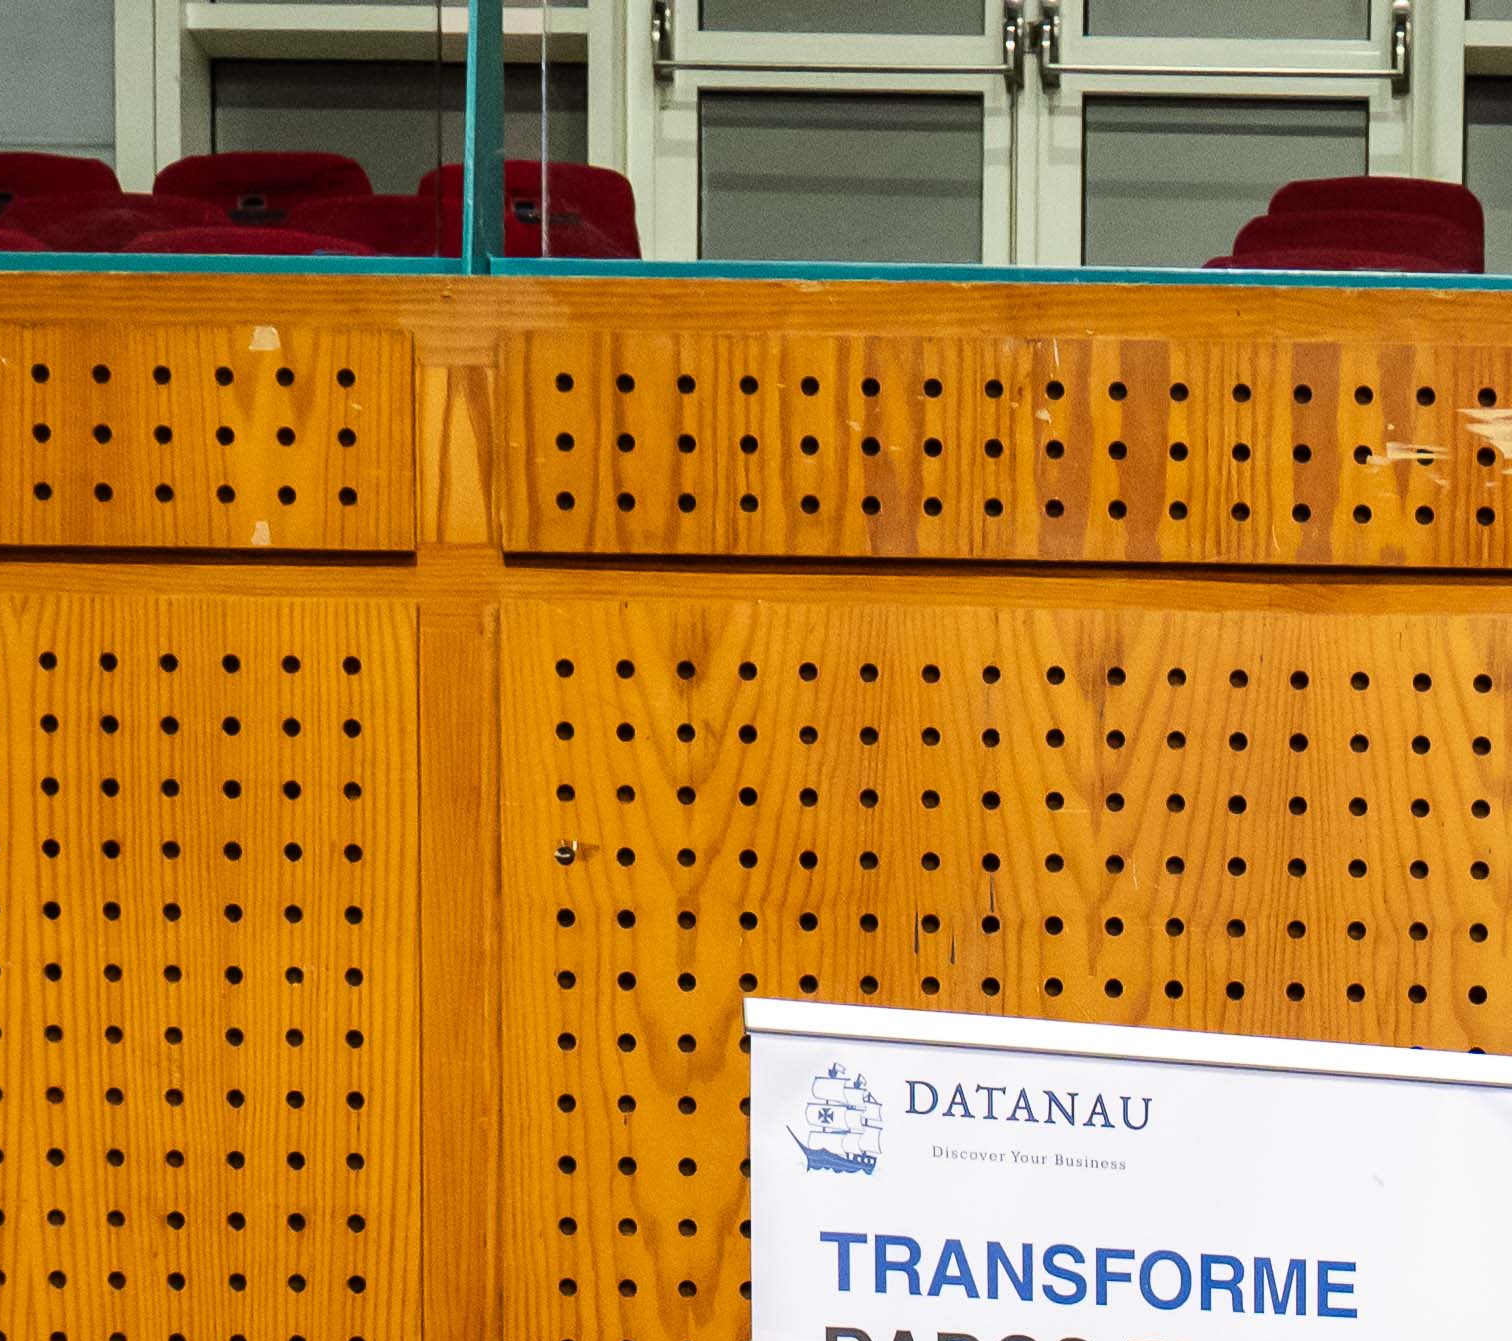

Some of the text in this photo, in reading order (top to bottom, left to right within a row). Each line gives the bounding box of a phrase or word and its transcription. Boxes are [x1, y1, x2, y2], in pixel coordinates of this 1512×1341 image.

[907, 1082, 1153, 1131] DATANAU
[931, 1145, 1126, 1170] Discover Your Business
[821, 1233, 1358, 1319] TRANSFORME
